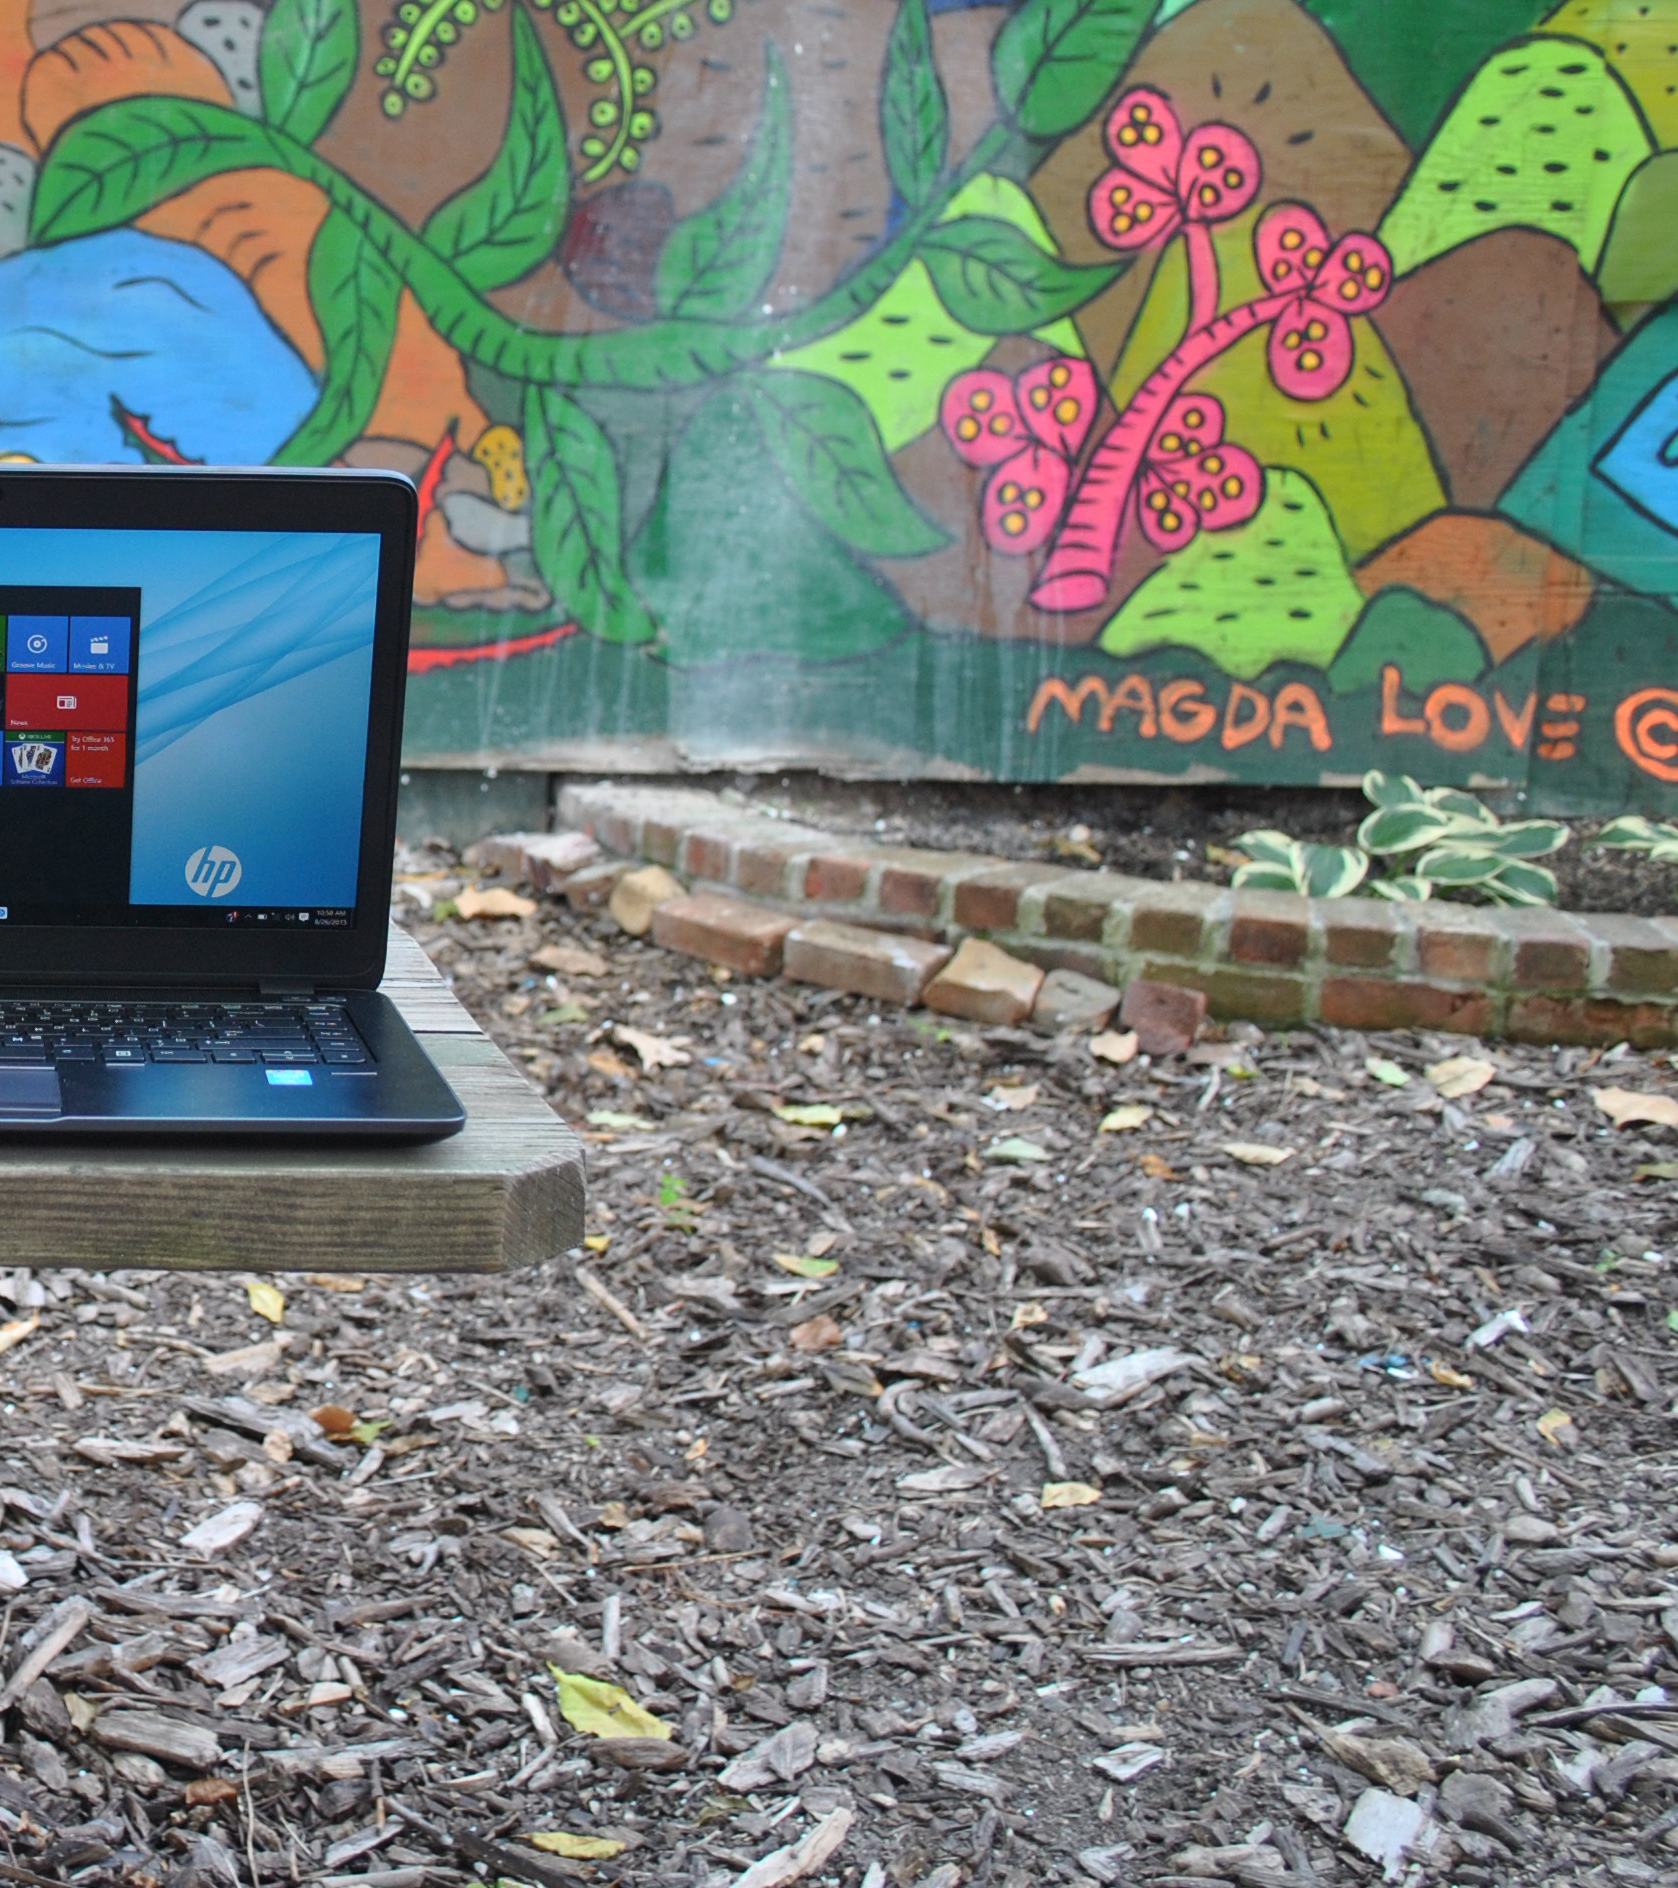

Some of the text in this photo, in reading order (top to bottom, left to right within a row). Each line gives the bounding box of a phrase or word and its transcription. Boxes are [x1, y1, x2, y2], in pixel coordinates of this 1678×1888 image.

[1027, 674, 1333, 752] MAGDA
[1382, 663, 1586, 761] LOVE
[185, 846, 242, 898] hp
